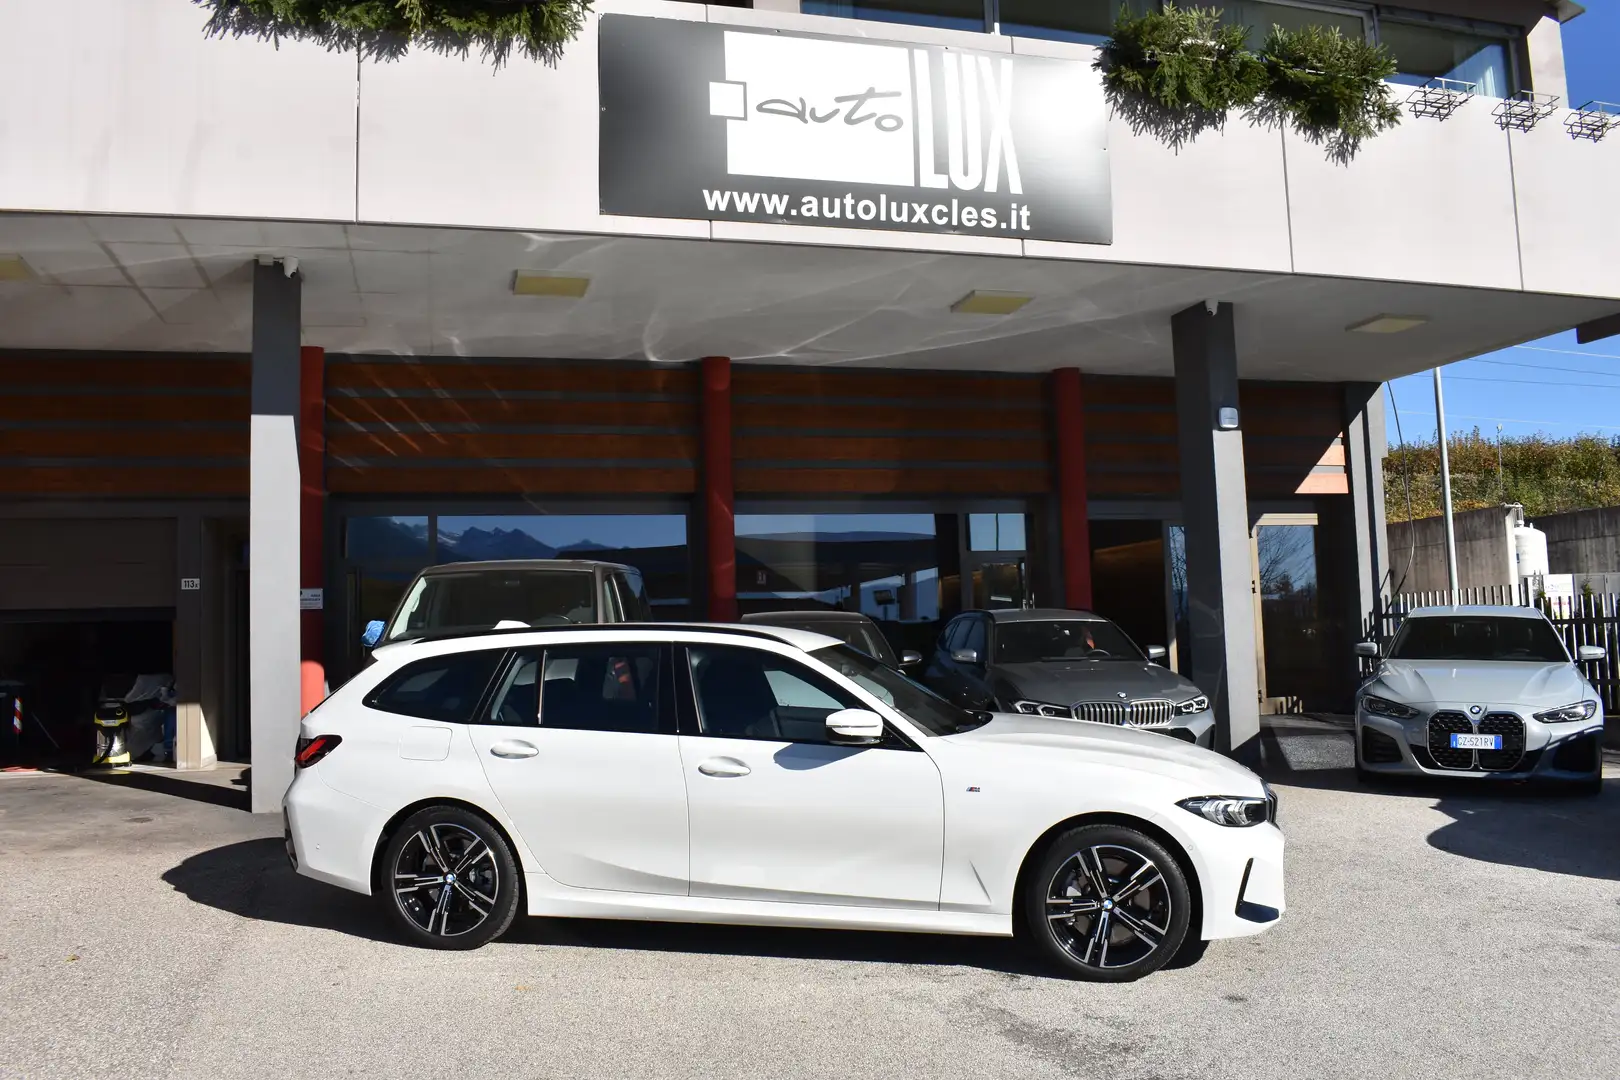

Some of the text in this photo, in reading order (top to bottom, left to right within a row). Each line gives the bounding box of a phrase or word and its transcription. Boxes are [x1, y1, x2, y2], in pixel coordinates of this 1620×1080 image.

[756, 48, 1023, 194] auto LUX
[703, 189, 1031, 231] www.autoluxcles.it
